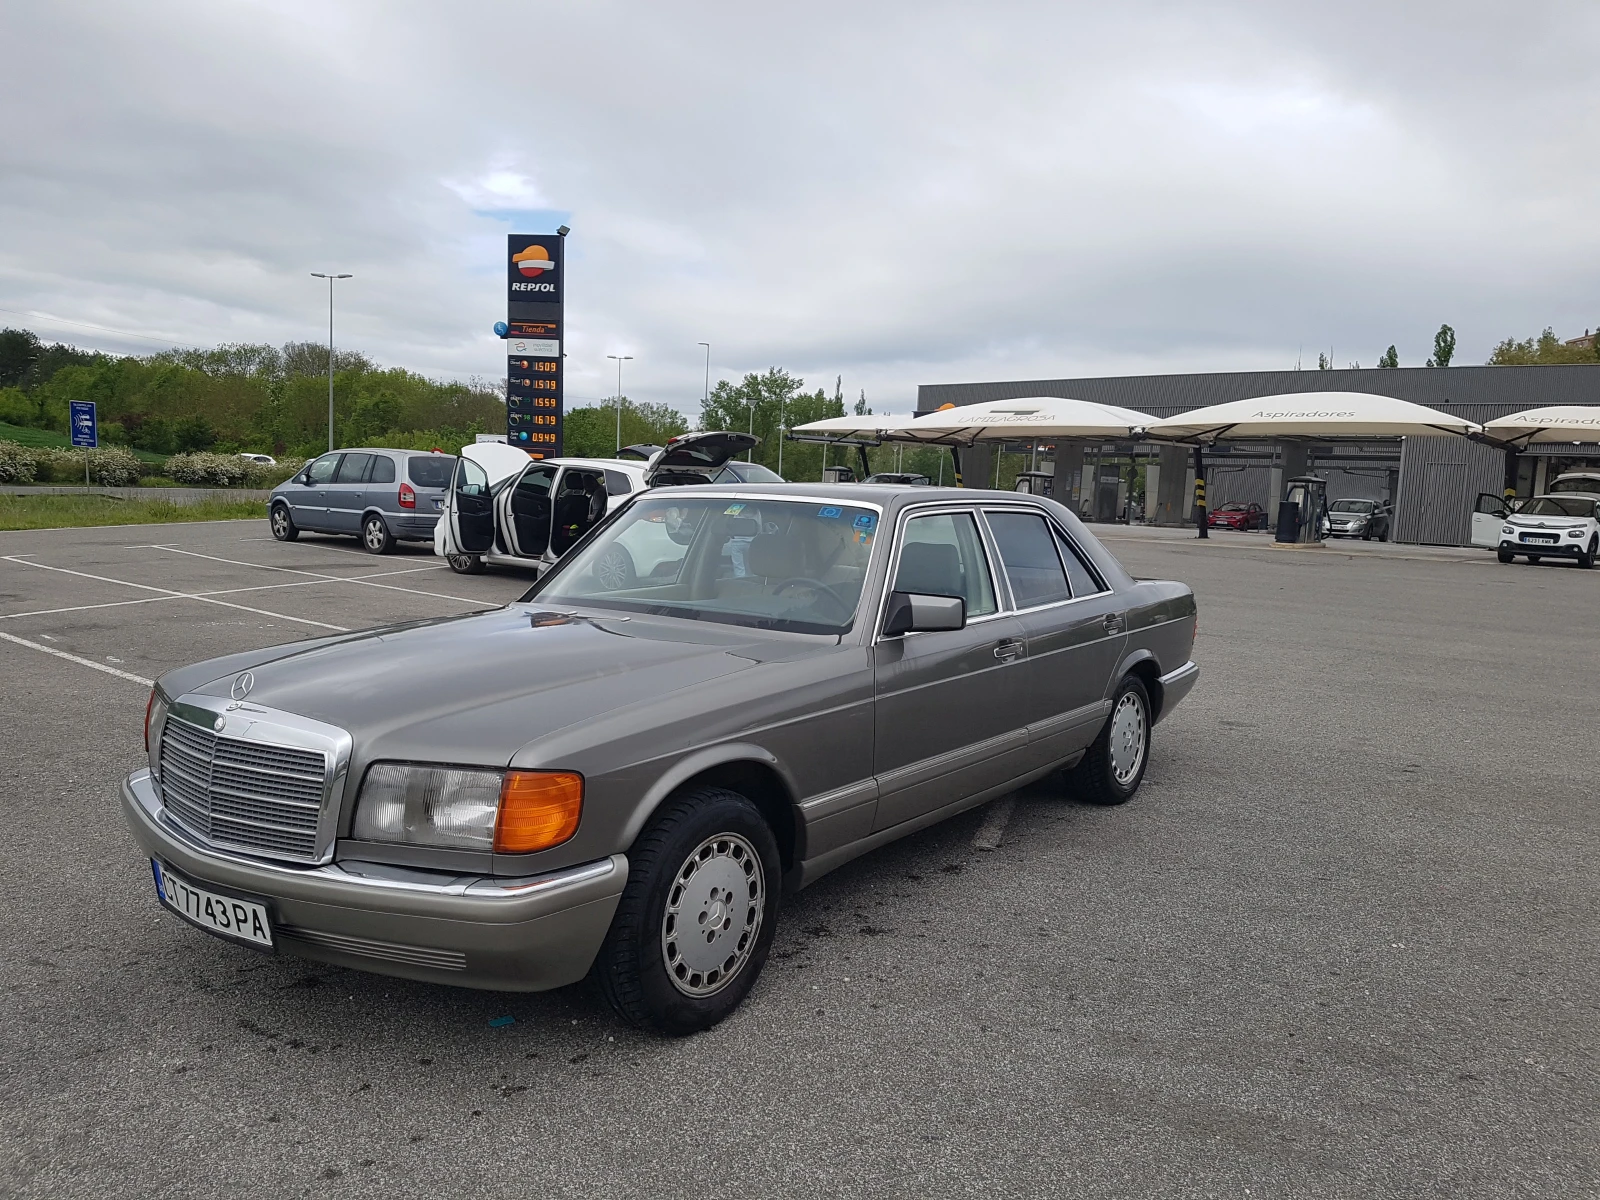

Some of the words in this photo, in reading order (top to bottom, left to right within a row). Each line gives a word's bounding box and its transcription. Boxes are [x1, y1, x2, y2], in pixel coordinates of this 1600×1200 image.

[512, 282, 555, 292] REPSOL
[535, 362, 556, 372] 1.509
[535, 380, 556, 389] 1.579
[535, 397, 556, 407] 1.559
[1251, 410, 1356, 419] Aspiradores
[535, 415, 556, 425] 1.679
[532, 432, 556, 443] 0.949
